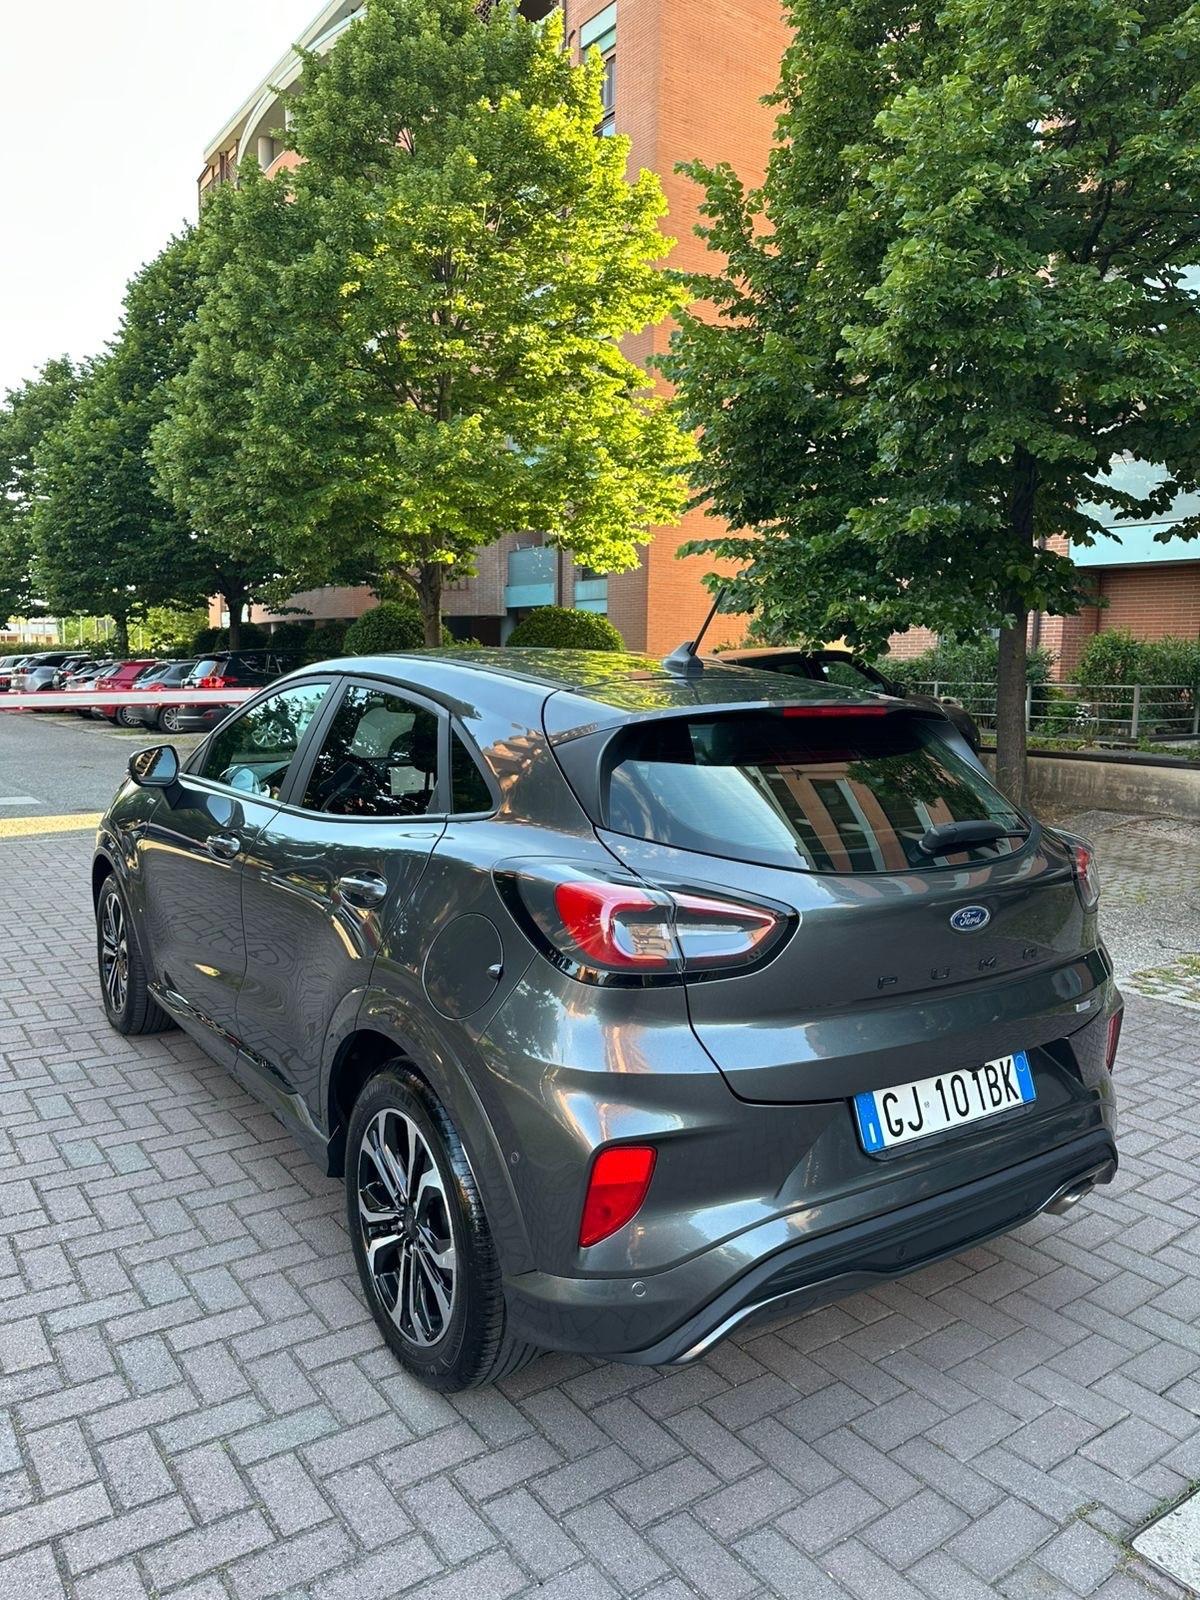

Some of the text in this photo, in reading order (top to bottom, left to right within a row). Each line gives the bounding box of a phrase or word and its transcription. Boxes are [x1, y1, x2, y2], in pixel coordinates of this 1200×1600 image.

[959, 910, 982, 926] Ford
[878, 948, 1038, 990] PUMA
[882, 1086, 923, 1137] GJ
